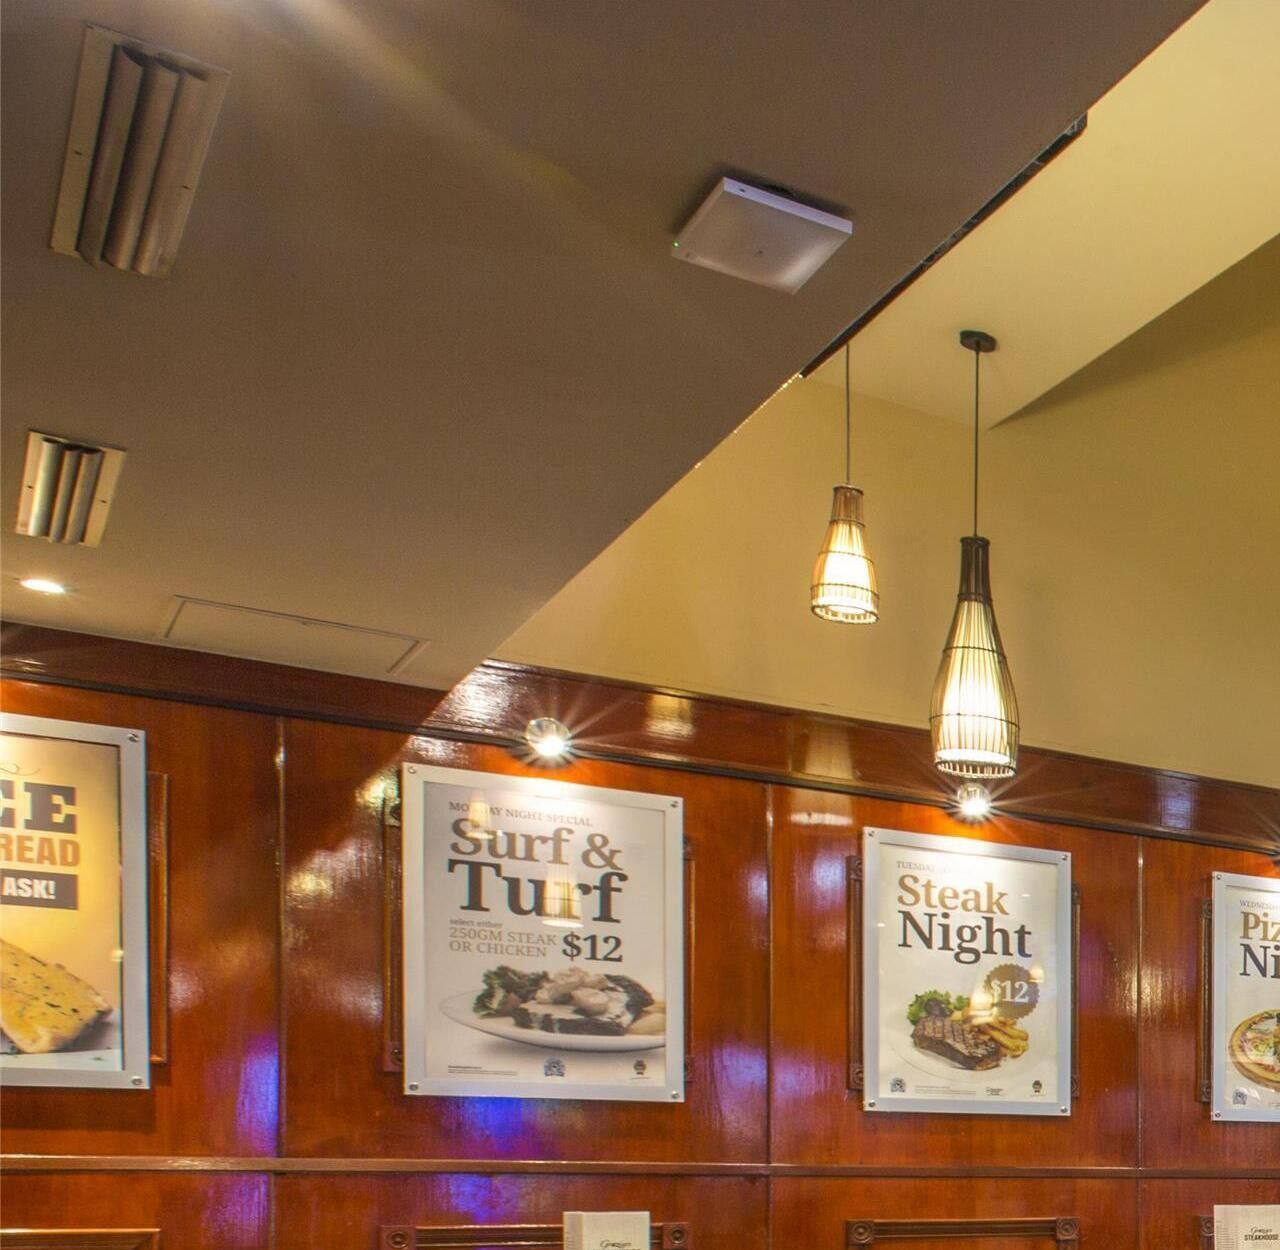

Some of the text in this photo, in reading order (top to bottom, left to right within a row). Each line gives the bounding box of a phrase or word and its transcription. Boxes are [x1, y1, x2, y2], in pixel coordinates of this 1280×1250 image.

[0, 779, 77, 834] E
[448, 801, 502, 817] MOAY
[450, 817, 624, 871] Surf &
[3, 876, 56, 900] ASK!
[448, 858, 629, 924] Turf
[897, 873, 1010, 916] Steak
[448, 927, 557, 946] 250GM STEAK
[448, 939, 549, 958] OR CHICKEN
[561, 930, 624, 963] $12
[897, 909, 1033, 965] Night
[991, 978, 1030, 1002] $12
